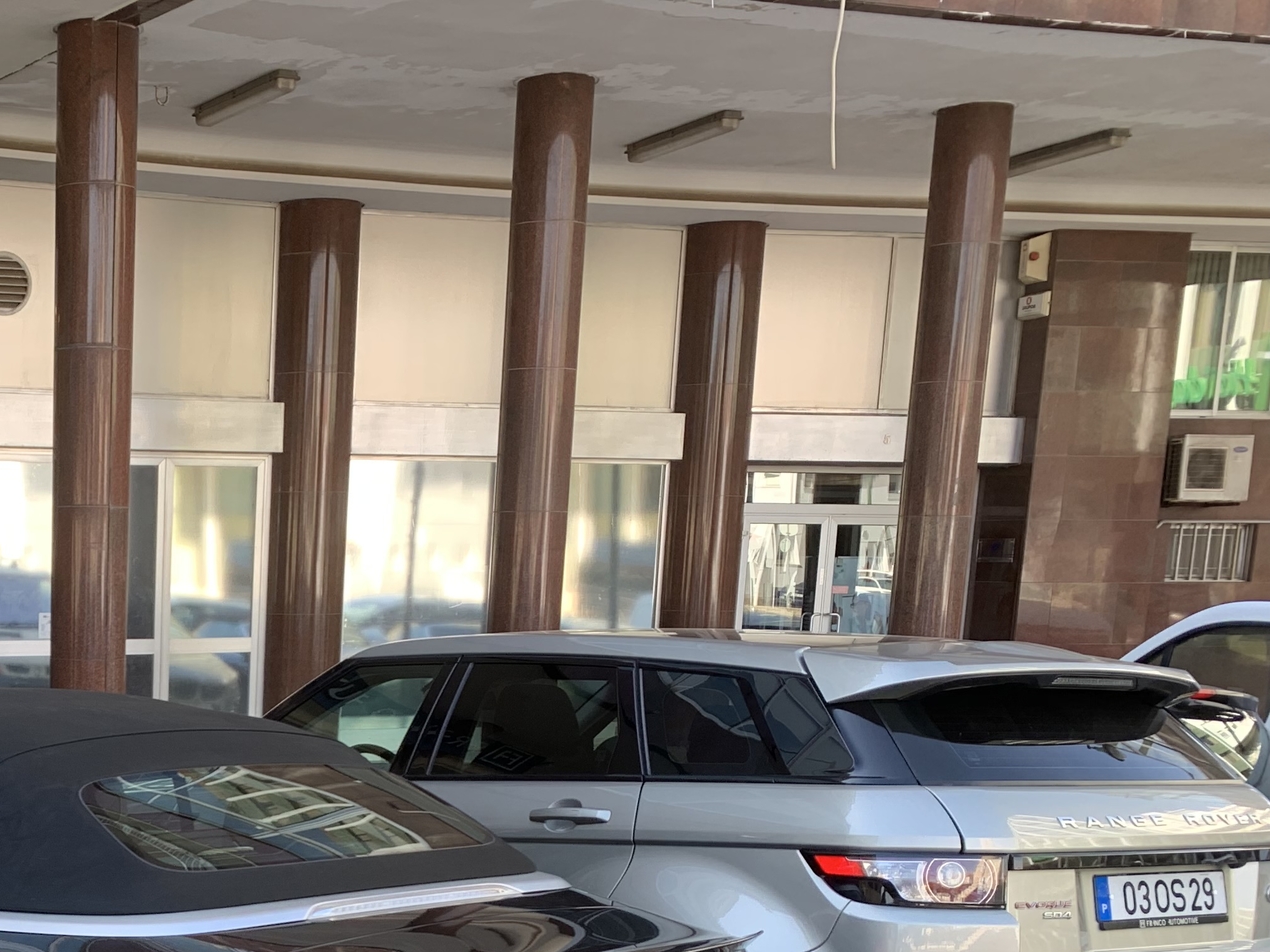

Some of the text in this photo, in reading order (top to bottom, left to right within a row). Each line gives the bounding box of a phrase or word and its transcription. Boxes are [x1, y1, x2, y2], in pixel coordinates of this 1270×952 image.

[1056, 811, 1264, 829] RANGE ROVER
[1102, 903, 1108, 914] P
[1042, 911, 1072, 920] SD4
